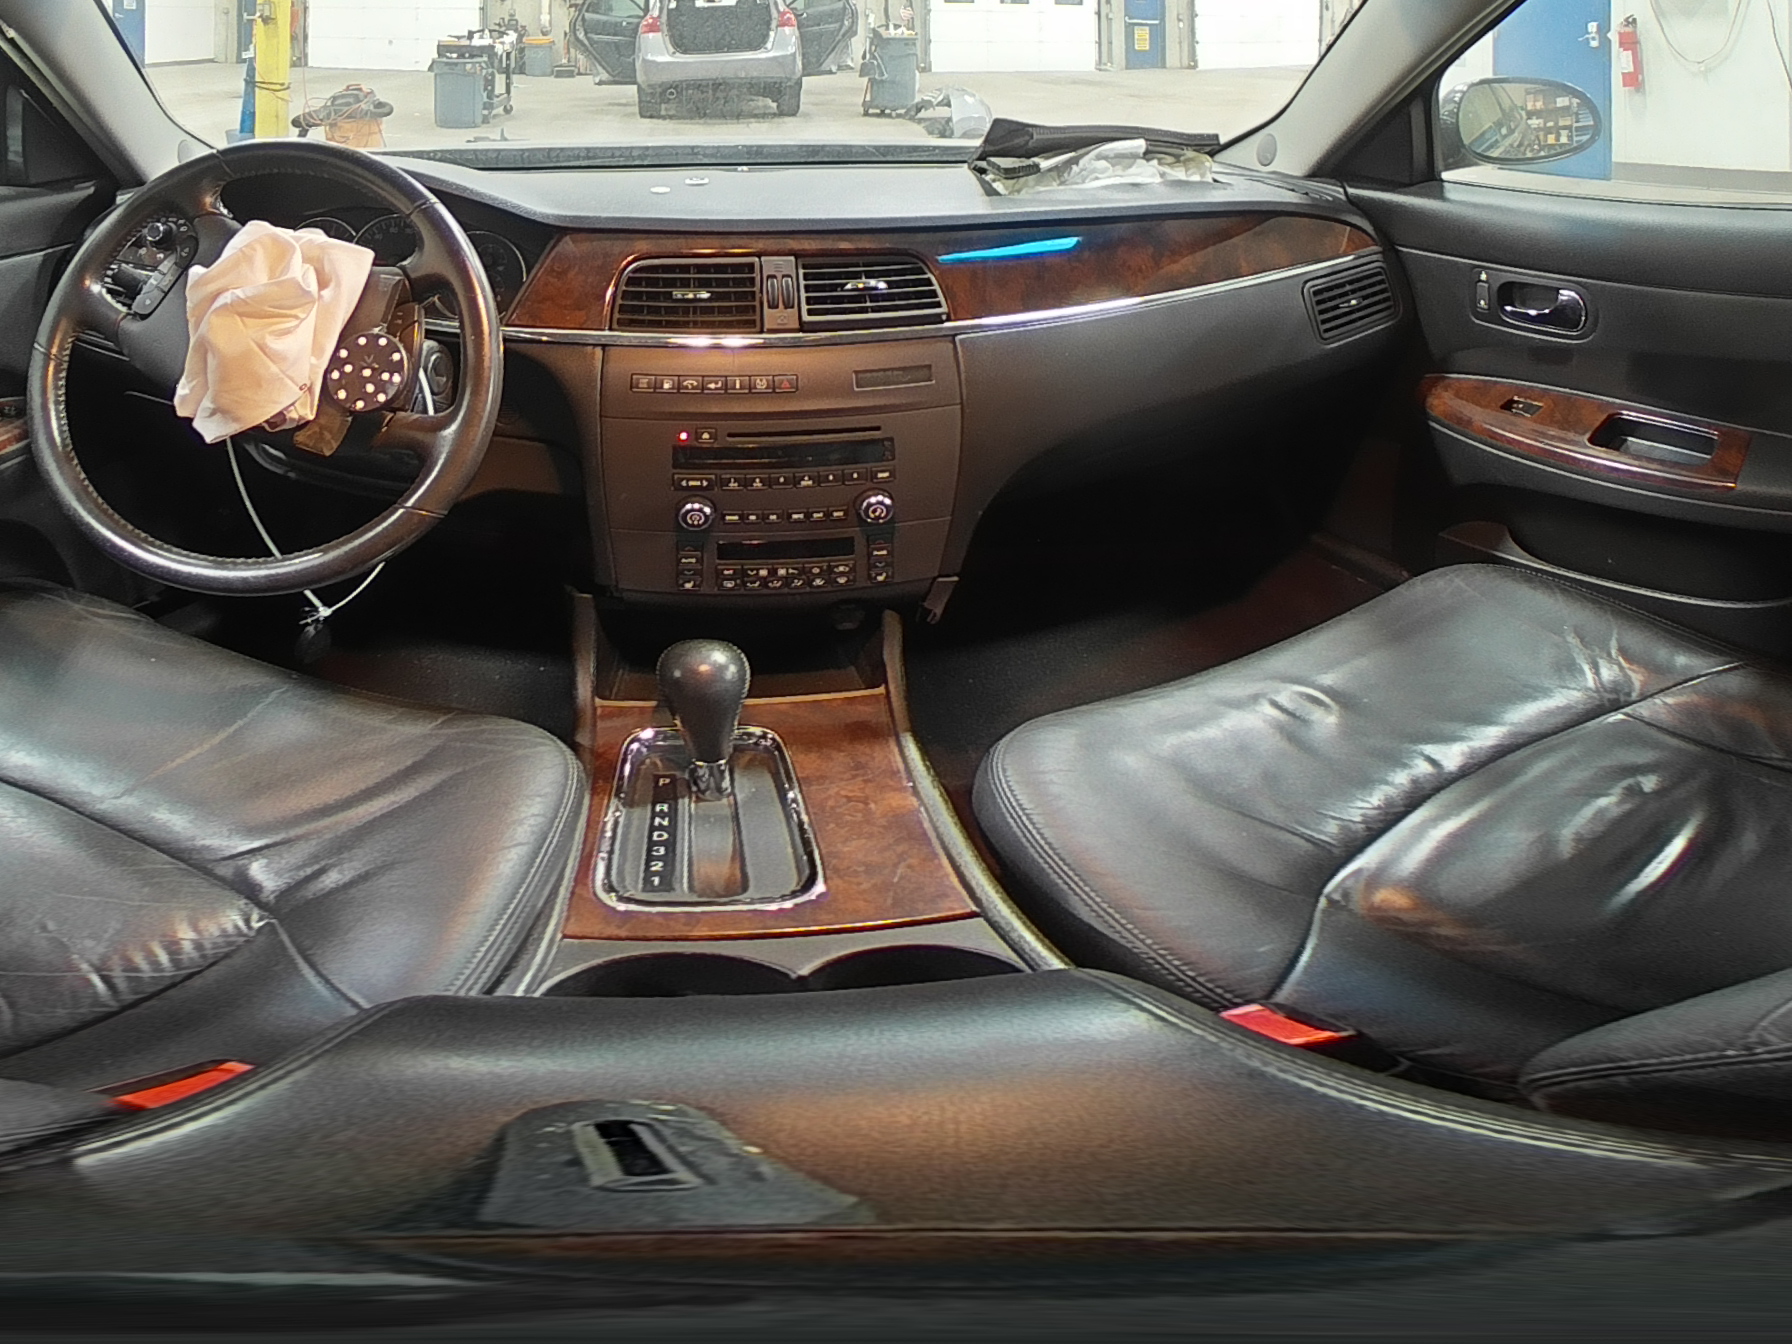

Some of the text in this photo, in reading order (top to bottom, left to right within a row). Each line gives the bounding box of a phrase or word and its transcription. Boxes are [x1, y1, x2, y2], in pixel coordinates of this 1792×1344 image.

[649, 777, 671, 886] P R N D 3 2 1
